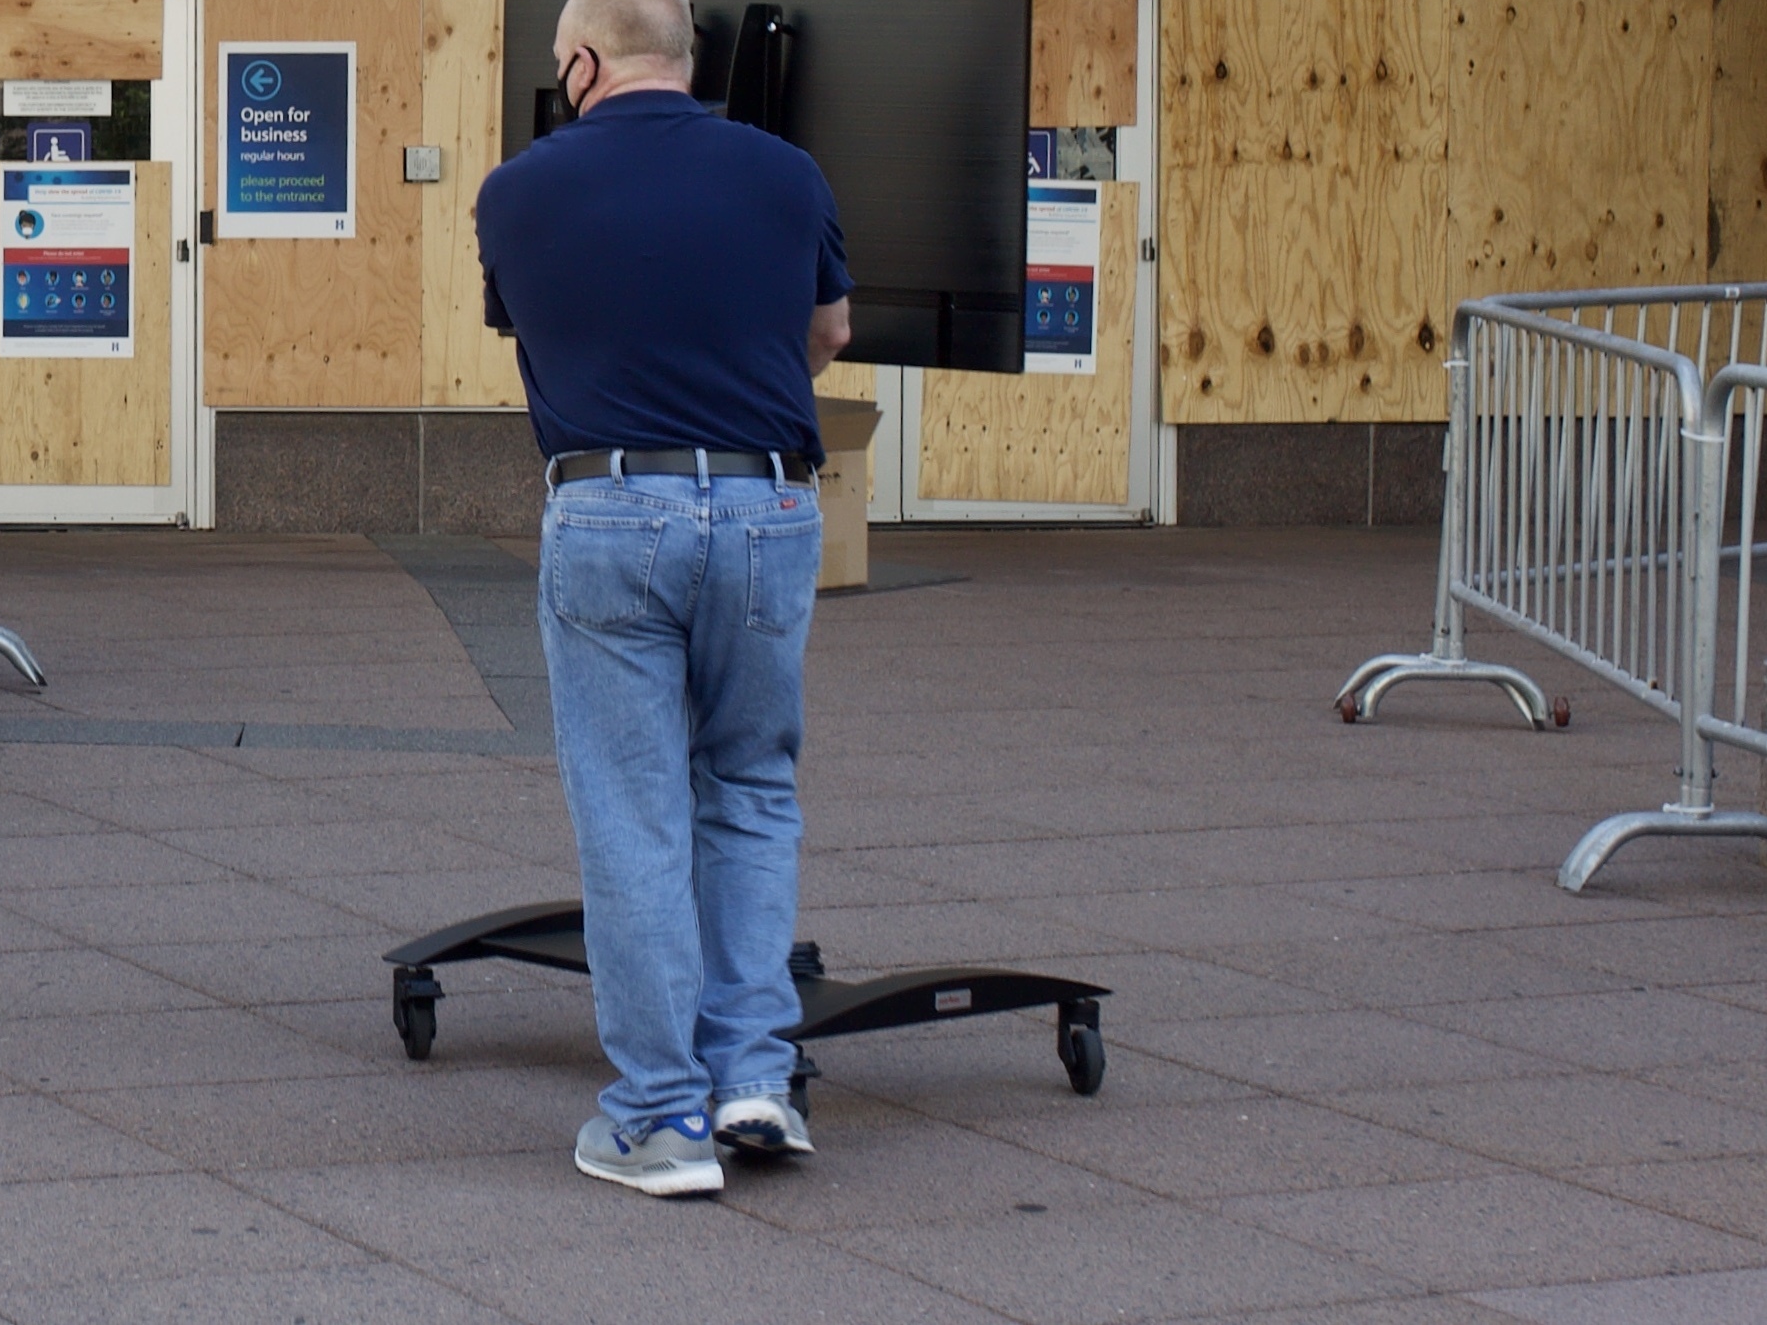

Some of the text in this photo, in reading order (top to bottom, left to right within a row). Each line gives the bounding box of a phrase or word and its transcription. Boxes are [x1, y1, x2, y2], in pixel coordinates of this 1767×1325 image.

[240, 106, 311, 126] Open for
[240, 127, 308, 142] business
[240, 150, 305, 164] regular hours
[240, 175, 325, 188] please proceed
[240, 191, 325, 202] to the entrance
